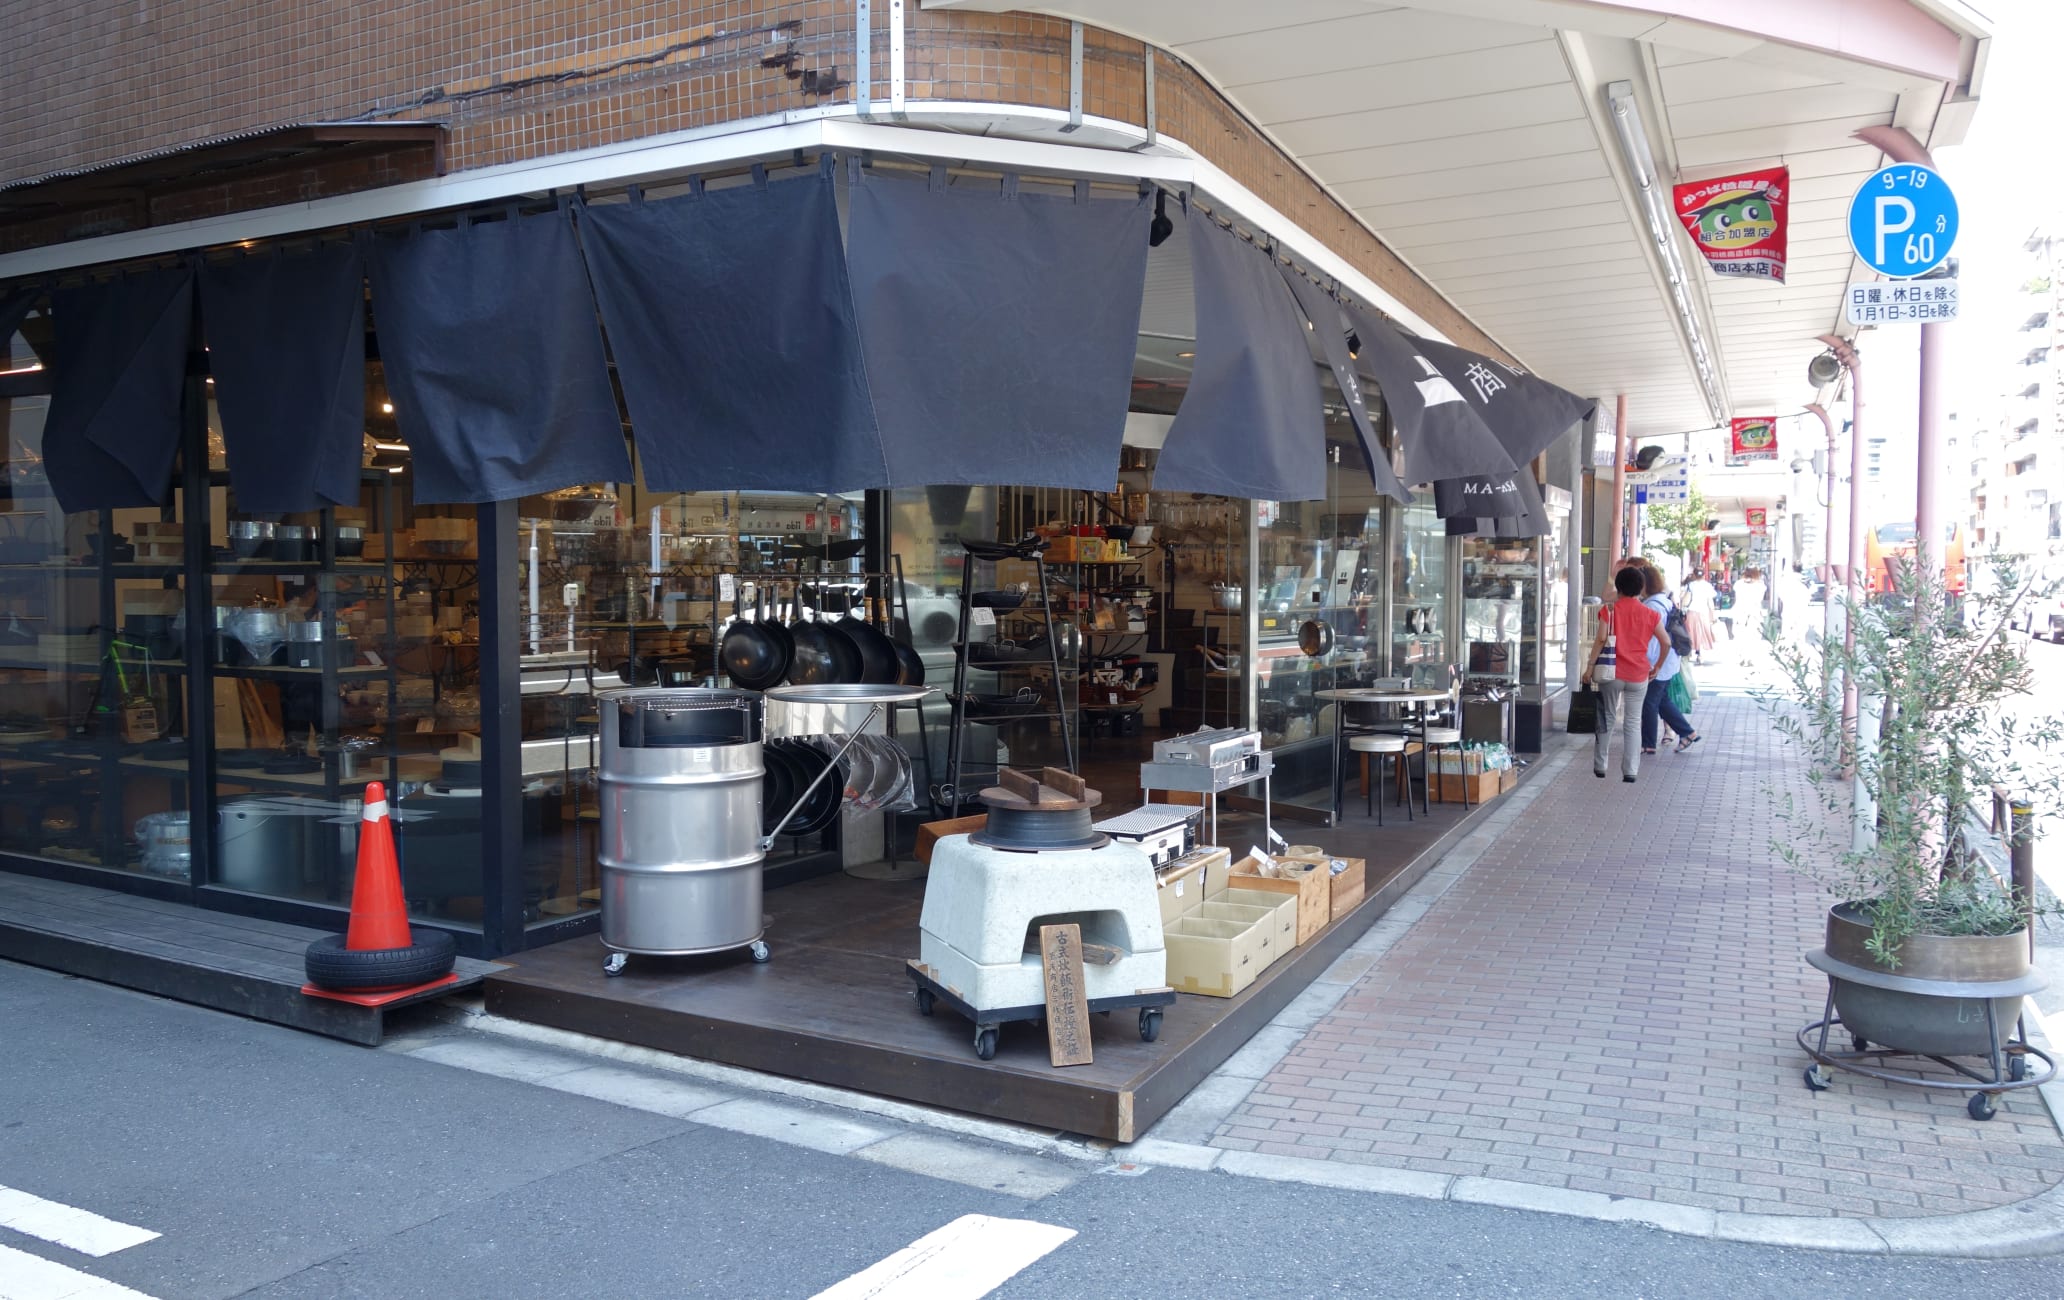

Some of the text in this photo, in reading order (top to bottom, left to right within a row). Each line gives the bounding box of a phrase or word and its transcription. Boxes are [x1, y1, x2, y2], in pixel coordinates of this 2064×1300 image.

[1882, 169, 1928, 190] 9-19
[1875, 195, 1916, 265] P
[1935, 214, 1947, 233] 分
[1700, 227, 1770, 242] 組合加盟店
[1904, 233, 1935, 265] 60
[1710, 262, 1770, 275] 商店本店
